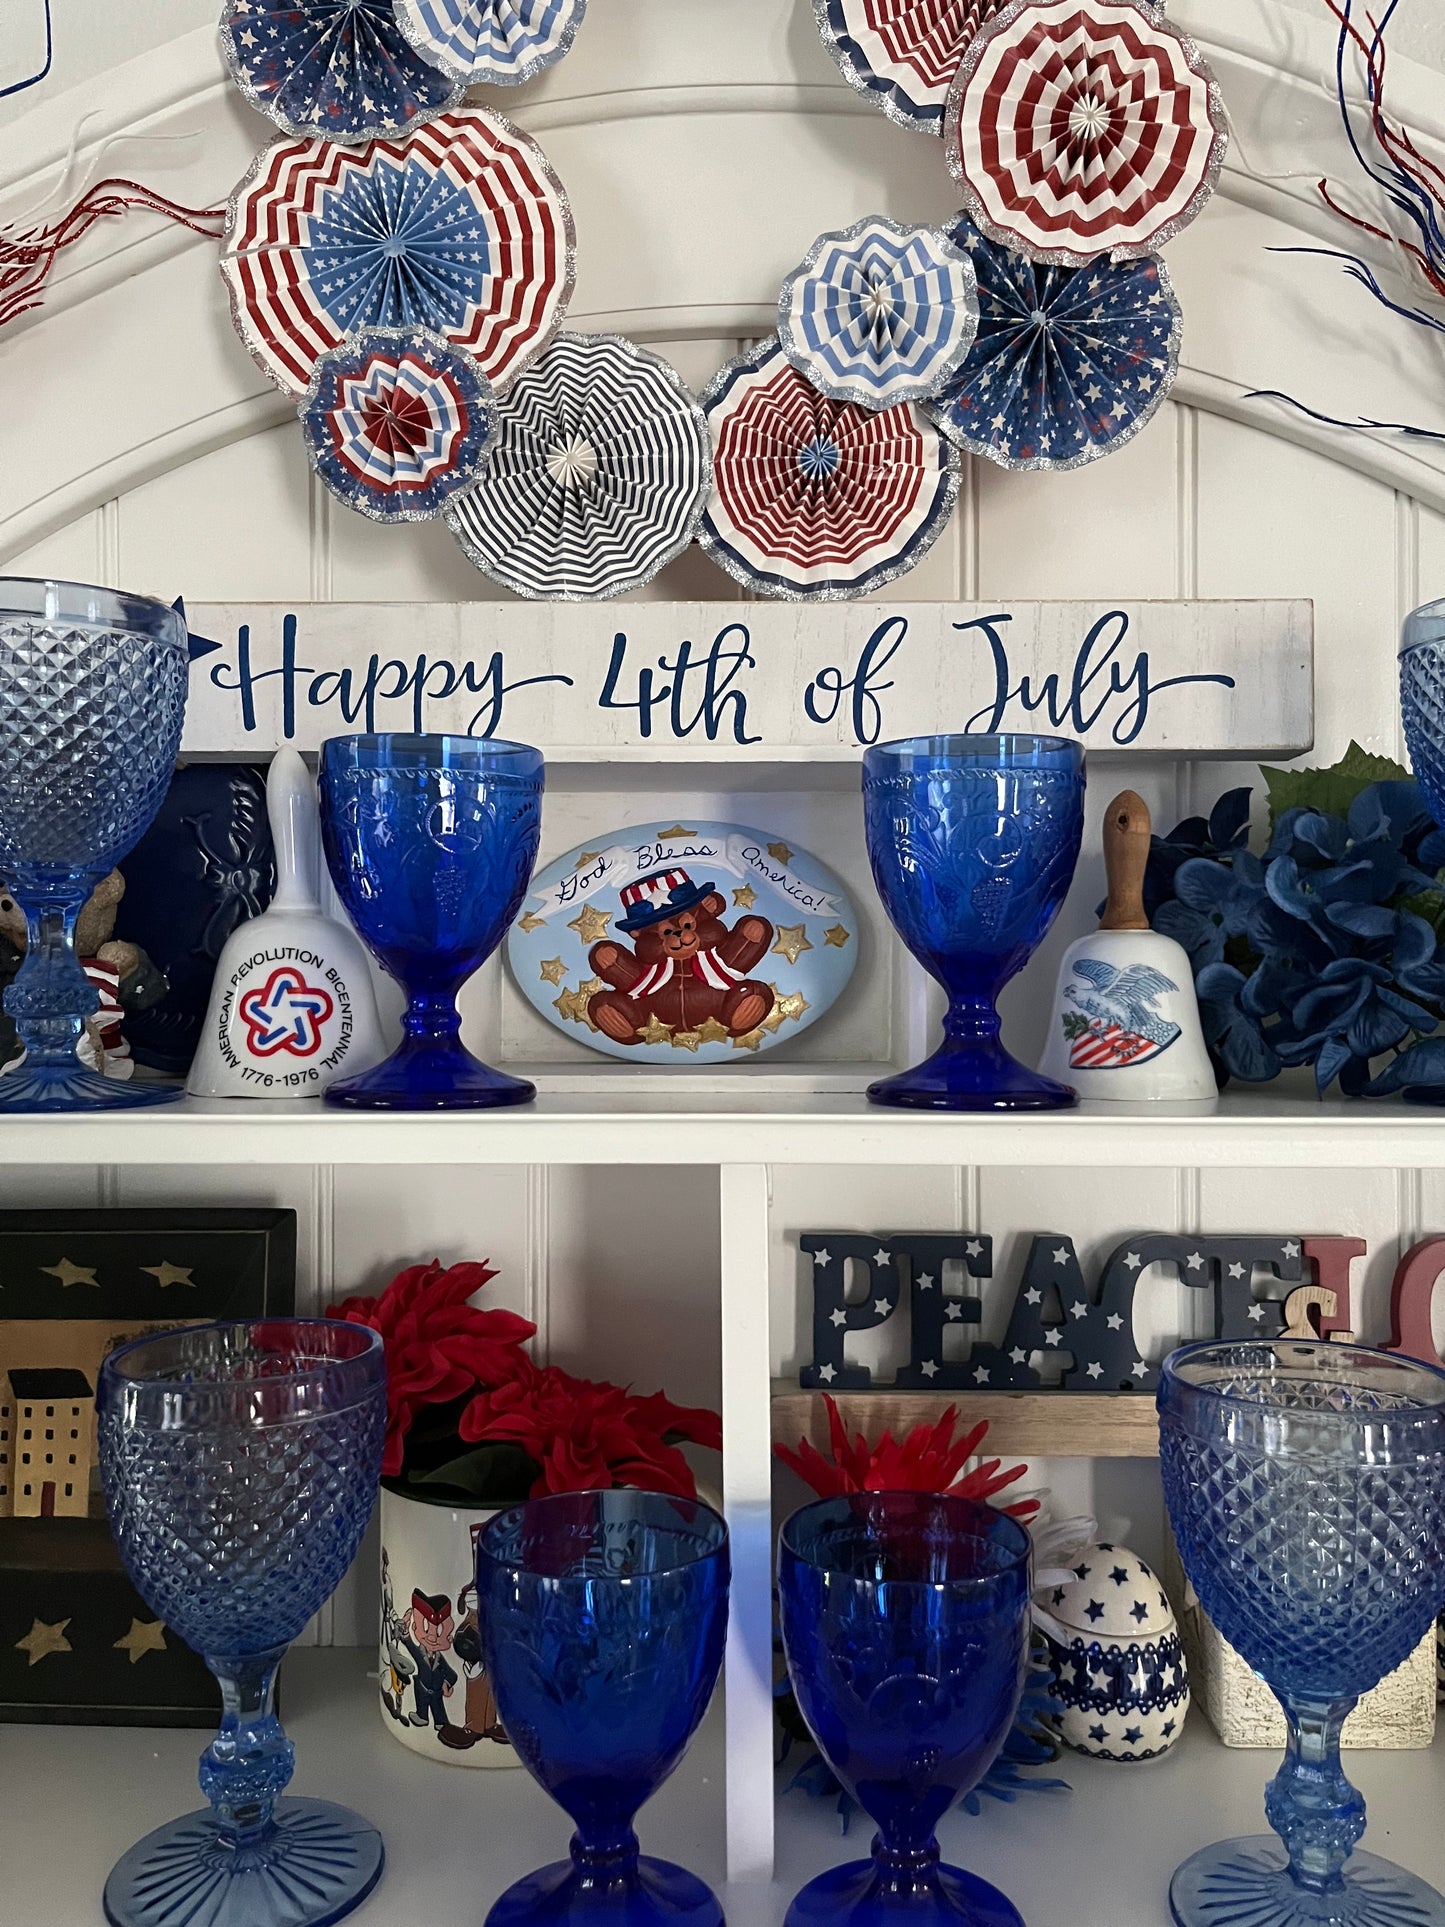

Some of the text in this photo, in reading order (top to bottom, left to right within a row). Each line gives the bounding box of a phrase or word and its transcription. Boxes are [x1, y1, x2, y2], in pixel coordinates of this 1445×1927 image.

[210, 610, 1236, 746] Happy 4th of July
[555, 855, 613, 905] God
[633, 843, 718, 870] Bless
[218, 947, 353, 1071] AMERICAN REVOLUTION BICENTENNIAL
[240, 1066, 319, 1087] 1776-1976
[799, 1234, 1302, 1390] PEACE
